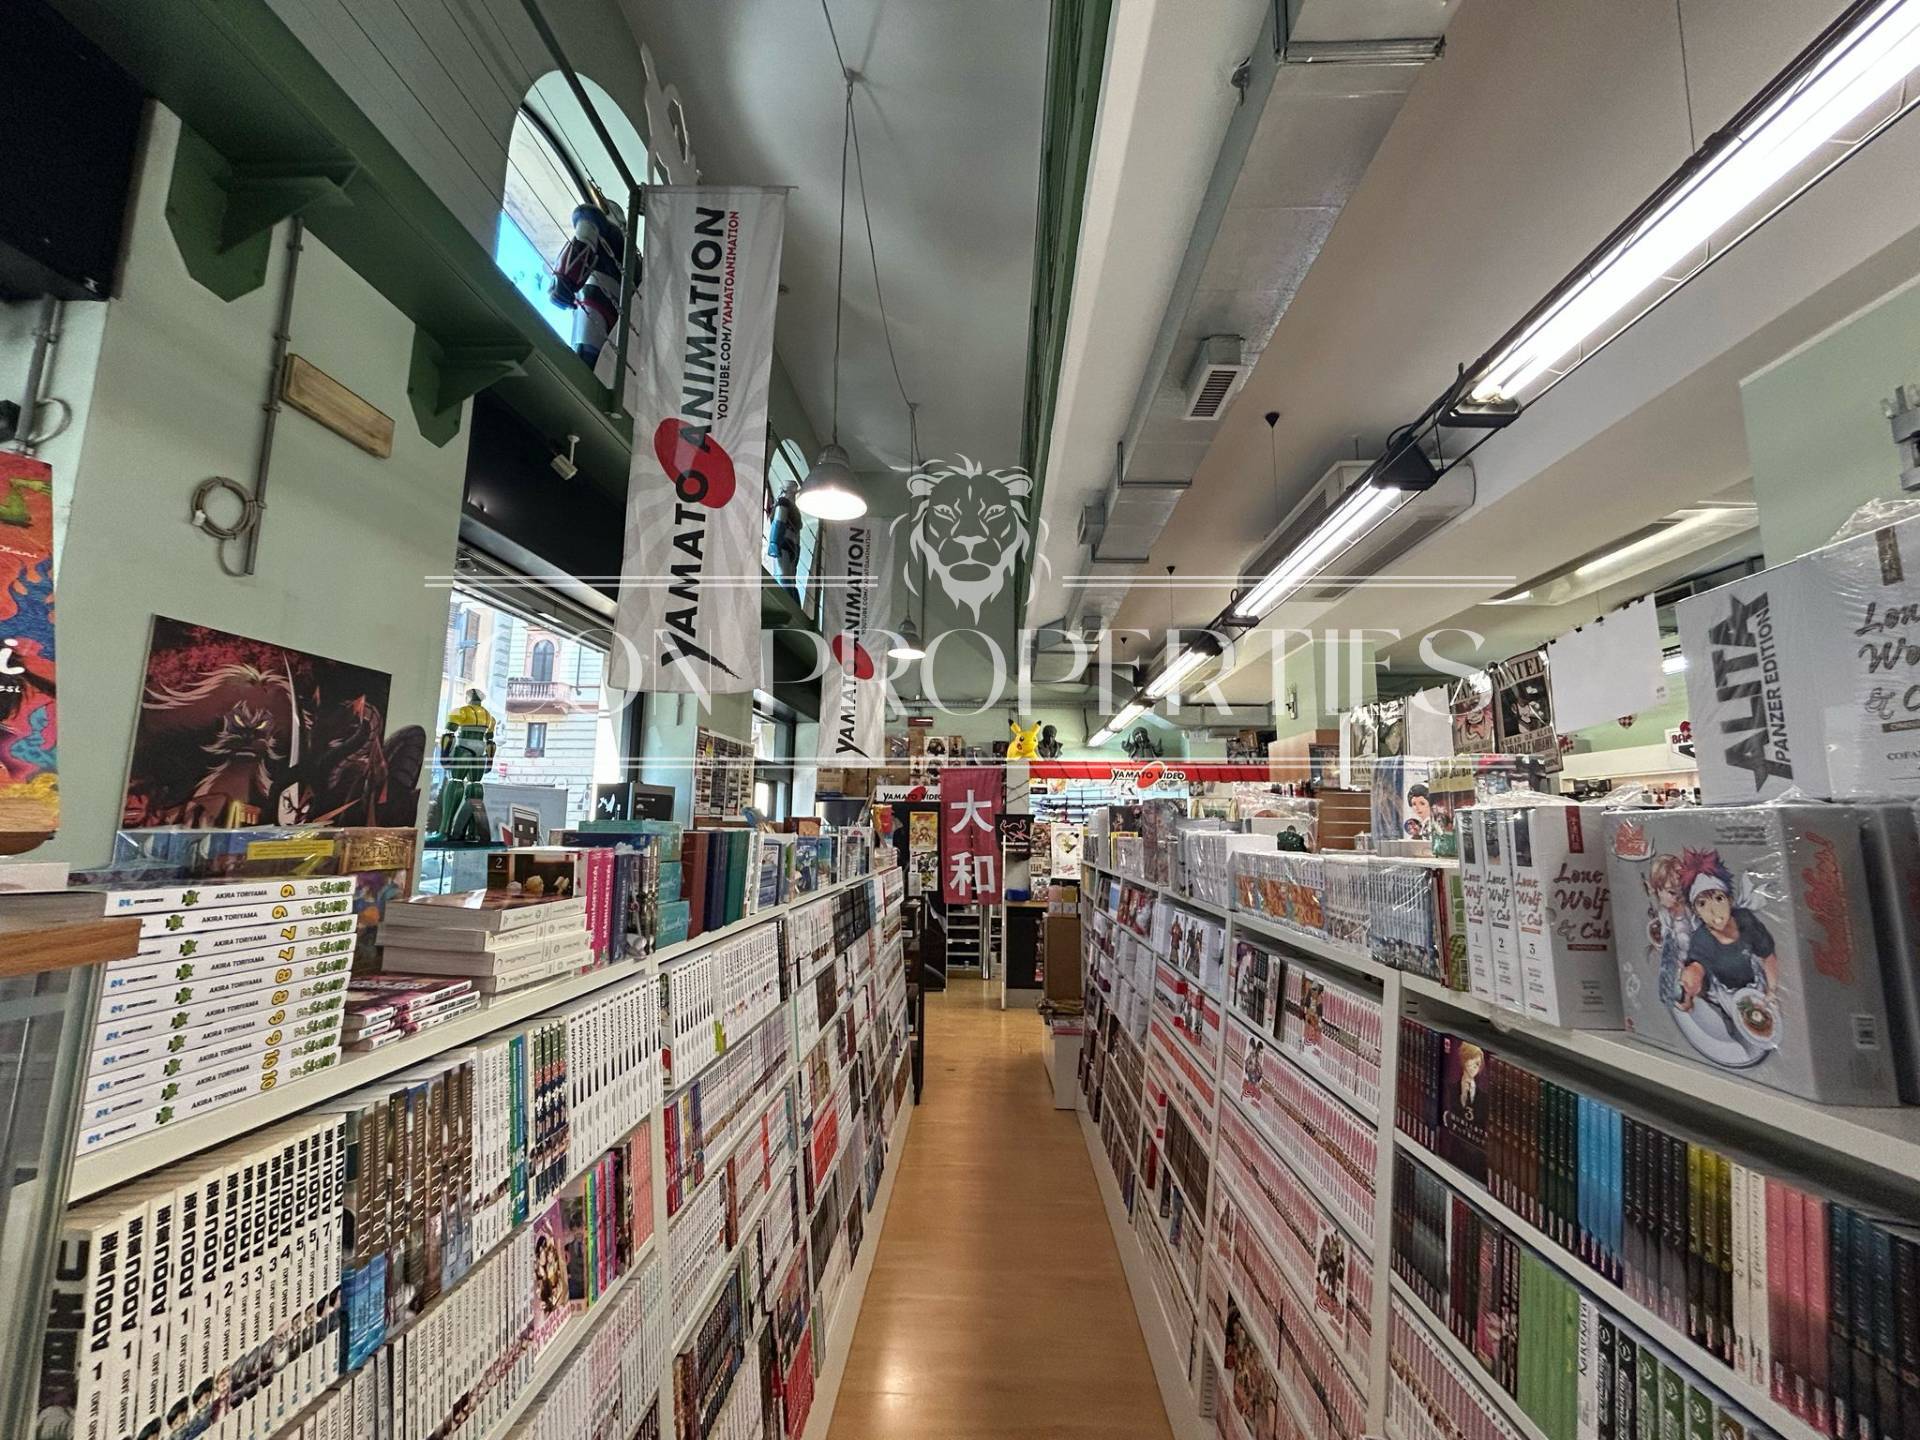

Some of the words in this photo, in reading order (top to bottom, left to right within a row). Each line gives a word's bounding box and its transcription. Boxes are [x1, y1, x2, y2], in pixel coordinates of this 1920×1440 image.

[716, 210, 739, 420] YOUTUBE.COM/YAMATOANIMATION
[679, 206, 725, 453] ANIMATION
[661, 469, 742, 680] YAMATO
[845, 527, 865, 652] ANIMATION
[1854, 601, 1920, 636] Lon
[1756, 607, 1779, 684] EDITION
[1858, 637, 1920, 674] Wo
[1709, 592, 1793, 792] ALITA
[835, 661, 871, 760] YAMATO
[1766, 687, 1791, 763] PANZER
[1112, 768, 1154, 784] YAMATO
[1158, 769, 1184, 781] VIDEO
[883, 792, 918, 803] YAMATO
[950, 789, 995, 897] 大和
[1553, 862, 1603, 884] Lone
[236, 889, 268, 898] TORIYAMA
[1554, 887, 1610, 920] Wolf
[201, 914, 223, 923] AKIRA
[223, 911, 258, 920] TORIYAMA
[213, 938, 235, 948] AKIRA
[236, 934, 267, 944] TORIYAMA
[210, 962, 231, 970] AKIRA
[232, 956, 265, 967] TORIYAMA
[208, 983, 230, 993] AKIRA
[231, 978, 262, 990] TORIYAMA
[205, 1008, 225, 1017] AKIRA
[227, 1000, 259, 1013] TORIYAMA
[202, 1031, 222, 1040] AKIRA
[223, 1022, 255, 1035] TORIYAMA
[198, 1053, 218, 1063] AKIRA
[220, 1043, 252, 1057] TORIYAMA
[195, 1076, 217, 1087] AKIRA
[218, 1064, 250, 1080] TORIYAMA
[191, 1098, 212, 1109] AKIRA
[213, 1085, 247, 1102] TORIYAMA
[413, 1169, 425, 1221] ARIA
[432, 1156, 442, 1207] ARIA
[268, 1190, 280, 1249] ADOU
[280, 1178, 294, 1238] ADOU
[373, 1189, 386, 1246] ARIA
[394, 1178, 405, 1234] ARIA
[239, 1204, 253, 1264] ADOU
[253, 1196, 267, 1258] ADOU
[309, 1227, 317, 1243] 5
[322, 1221, 330, 1238] 7
[335, 1214, 342, 1229] 7
[358, 1201, 371, 1258] ARIA
[202, 1216, 219, 1283] ADOU
[222, 1208, 238, 1273] ADOU
[280, 1244, 291, 1261] 4
[296, 1236, 305, 1251] 5
[179, 1230, 196, 1299] ADOU
[254, 1265, 263, 1283] 3
[269, 1257, 278, 1273] 3
[151, 1244, 170, 1317] ADOU
[223, 1281, 234, 1299] 2
[240, 1271, 249, 1288] 3
[121, 1257, 141, 1333] ADOU
[204, 1291, 213, 1308] 1
[90, 1274, 116, 1352] ADOU
[181, 1307, 189, 1325] 1
[152, 1325, 161, 1343] 1
[123, 1341, 132, 1360] 1
[92, 1361, 103, 1381] 1
